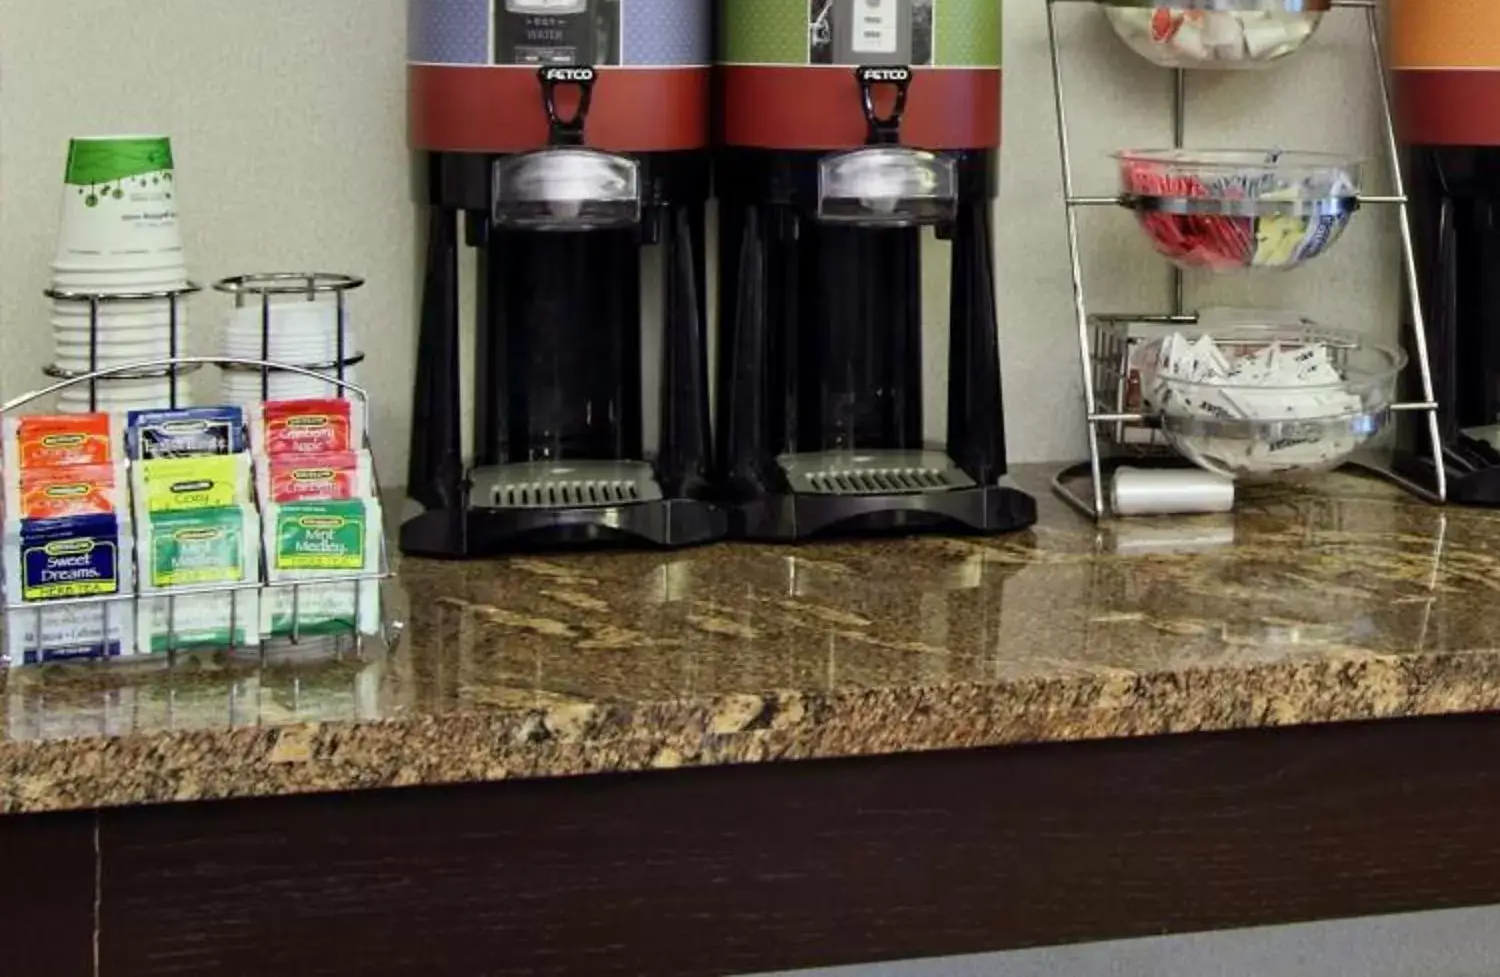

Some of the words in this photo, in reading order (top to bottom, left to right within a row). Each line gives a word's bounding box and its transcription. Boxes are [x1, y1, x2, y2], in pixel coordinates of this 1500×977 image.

[547, 68, 594, 80] FETCO
[863, 69, 908, 81] FETCO
[47, 554, 90, 568] Sweet
